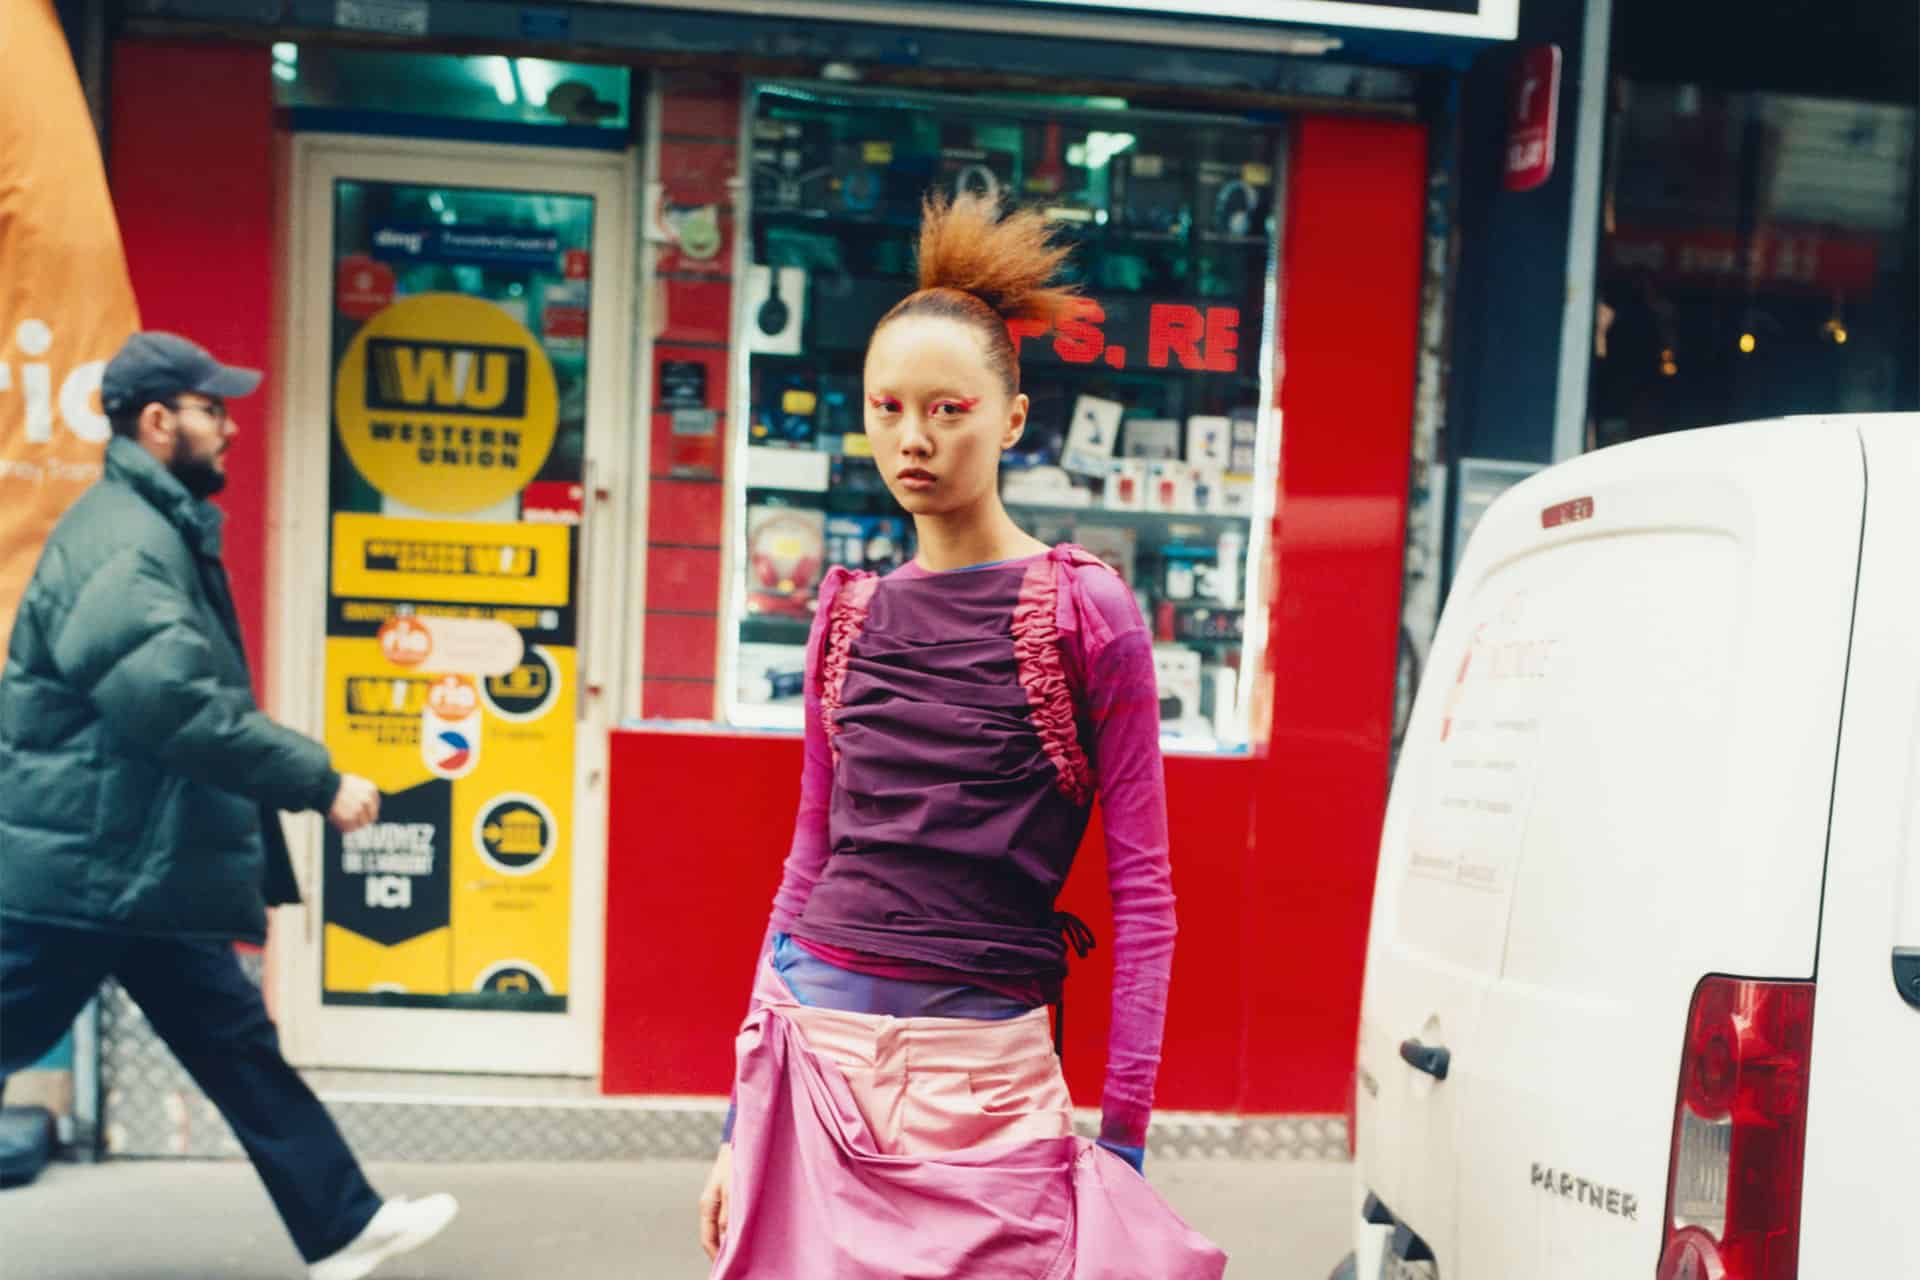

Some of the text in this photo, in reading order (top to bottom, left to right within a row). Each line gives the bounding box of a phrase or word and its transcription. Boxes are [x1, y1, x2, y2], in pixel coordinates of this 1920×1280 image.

[1148, 303, 1241, 373] RE
[0, 318, 113, 444] ia
[378, 345, 509, 409] WU
[370, 421, 521, 447] WESTERN
[418, 448, 518, 469] UNION
[365, 875, 412, 907] ICI
[1530, 1161, 1639, 1221] PARTNER
